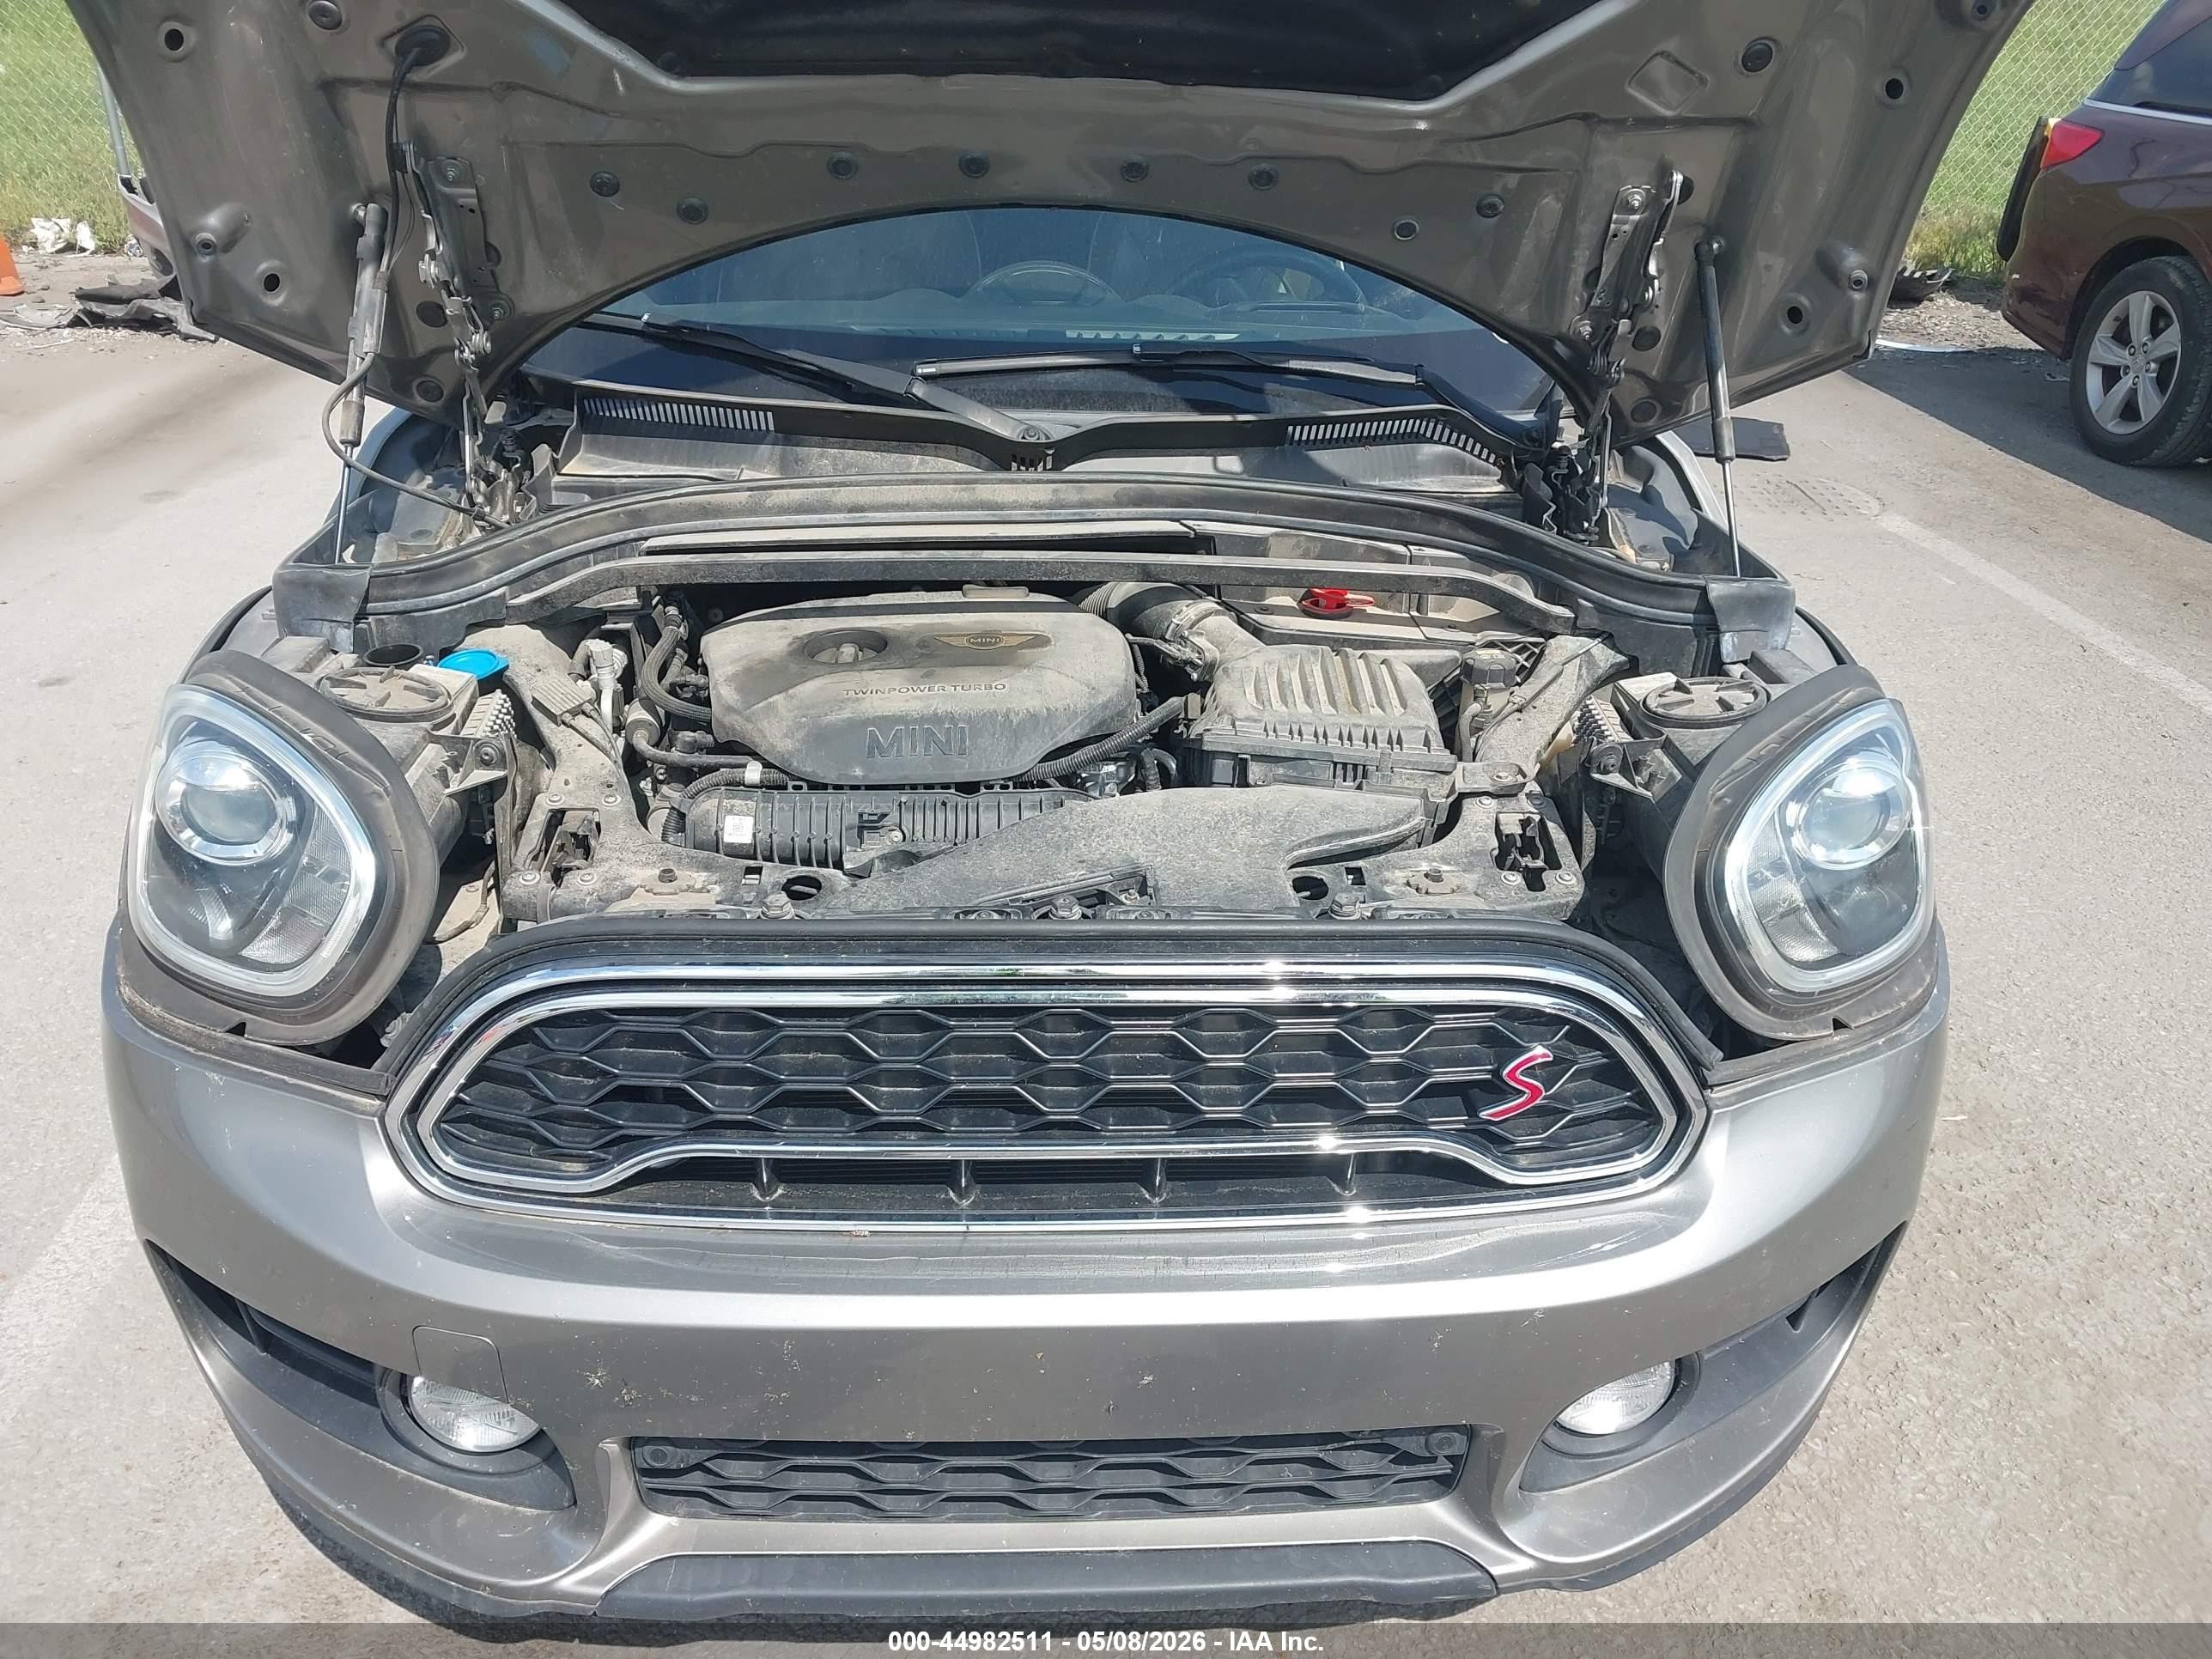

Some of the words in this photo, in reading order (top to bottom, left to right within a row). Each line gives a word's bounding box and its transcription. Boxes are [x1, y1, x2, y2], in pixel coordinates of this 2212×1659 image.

[843, 685, 946, 696] TWINPOWER
[951, 683, 1007, 692] TURBO
[866, 725, 969, 759] MINI
[1477, 1043, 1554, 1121] S
